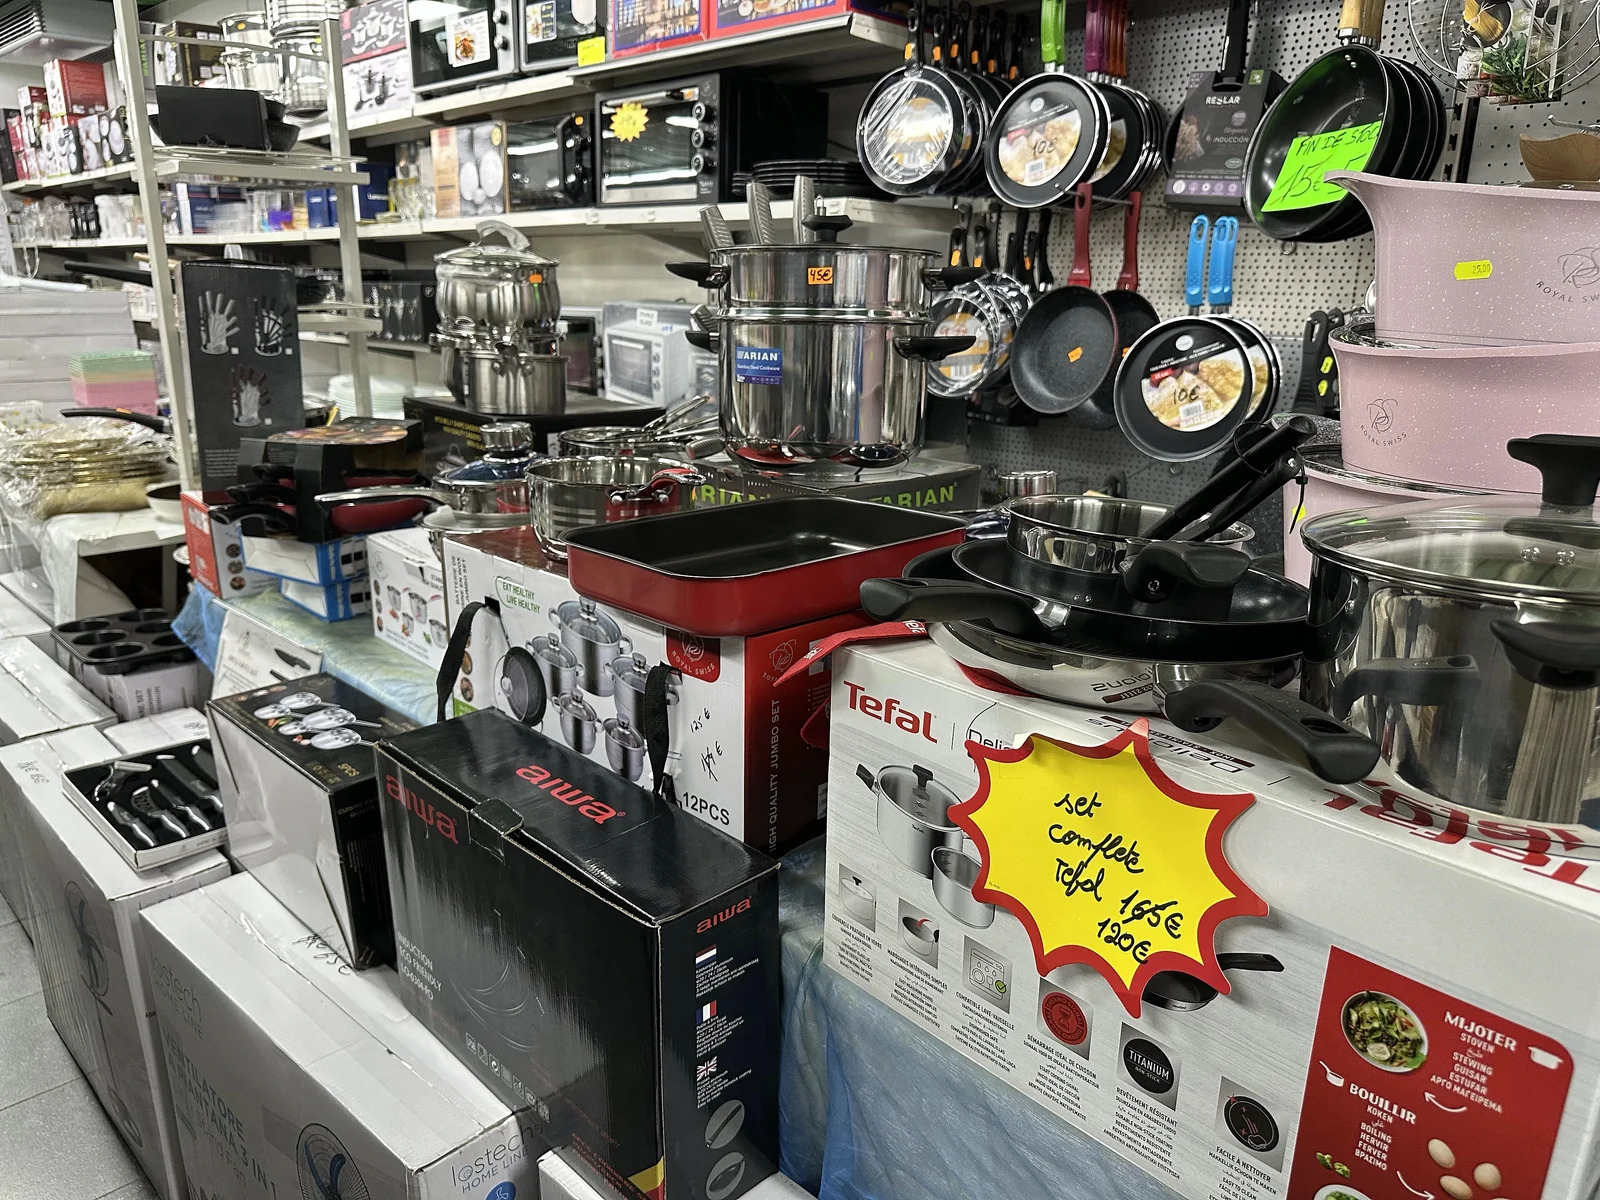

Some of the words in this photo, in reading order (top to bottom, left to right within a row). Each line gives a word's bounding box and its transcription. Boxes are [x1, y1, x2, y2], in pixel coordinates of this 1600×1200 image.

[809, 268, 833, 283] 45€
[1535, 280, 1573, 303] ROYAL
[1172, 385, 1201, 405] 10€
[1360, 424, 1380, 446] ROYAL
[1382, 431, 1407, 447] SWISS
[502, 581, 512, 593] EAT
[512, 584, 535, 600] HEALTHY
[505, 593, 519, 606] LIVE
[517, 598, 541, 614] HEALTHY
[671, 650, 693, 673] ROYAL
[694, 662, 716, 676] SWISS
[771, 699, 780, 724] SET
[843, 680, 938, 744] Tefal
[770, 726, 780, 770] JUMBO
[385, 771, 460, 845] aiwa
[515, 762, 618, 825] aiwa
[682, 792, 730, 826] 12PCS
[769, 773, 779, 824] QUALITY
[1053, 791, 1103, 819] set
[1048, 823, 1144, 874] complete
[1055, 857, 1107, 902] Tefal
[696, 898, 752, 934] aiwa
[397, 930, 434, 971] INDUCTION
[1097, 916, 1150, 965] 120€
[412, 958, 442, 992] FRIENDLY
[956, 991, 981, 1011] COMPATIBLE
[981, 1006, 1015, 1031] LAVE-VAISSELLE
[1444, 1010, 1517, 1052] MIJOTER
[1460, 1032, 1496, 1054] STOVEN
[1027, 1033, 1055, 1055] DÉMARRAGE
[1054, 1050, 1068, 1063] IDÉAL
[1068, 1058, 1075, 1067] DE
[1075, 1063, 1097, 1080] CUISSON
[1129, 1049, 1170, 1080] TITANIUM
[1452, 1051, 1493, 1076] STEWING
[1453, 1063, 1488, 1084] GUISAR
[162, 1028, 245, 1142] VENTILATORE
[1448, 1071, 1488, 1095] ESTUFAR
[1116, 1087, 1149, 1110] REVÊTEMENT
[1149, 1106, 1178, 1128] RÉSISTANT
[1349, 1082, 1417, 1125] BOUILLIR
[1366, 1104, 1394, 1124] KOKEN
[1359, 1131, 1389, 1153] HERVIR
[1360, 1121, 1393, 1144] BOILING
[451, 1125, 534, 1187] lostech
[1216, 1145, 1236, 1162] FACILE
[1236, 1156, 1241, 1166] À
[1241, 1161, 1271, 1183] NETTOYER
[1358, 1140, 1388, 1162] FERVER
[239, 1142, 248, 1169] 3
[251, 1156, 267, 1191] IN
[269, 1177, 277, 1200] 1
[461, 1165, 499, 1194] HOME
[502, 1147, 529, 1169] LINE
[1222, 1176, 1235, 1188] EASY
[1234, 1184, 1241, 1192] TO
[1233, 1166, 1253, 1181] SCHOON
[1253, 1177, 1259, 1185] TE
[1259, 1181, 1277, 1195] MAKEN
